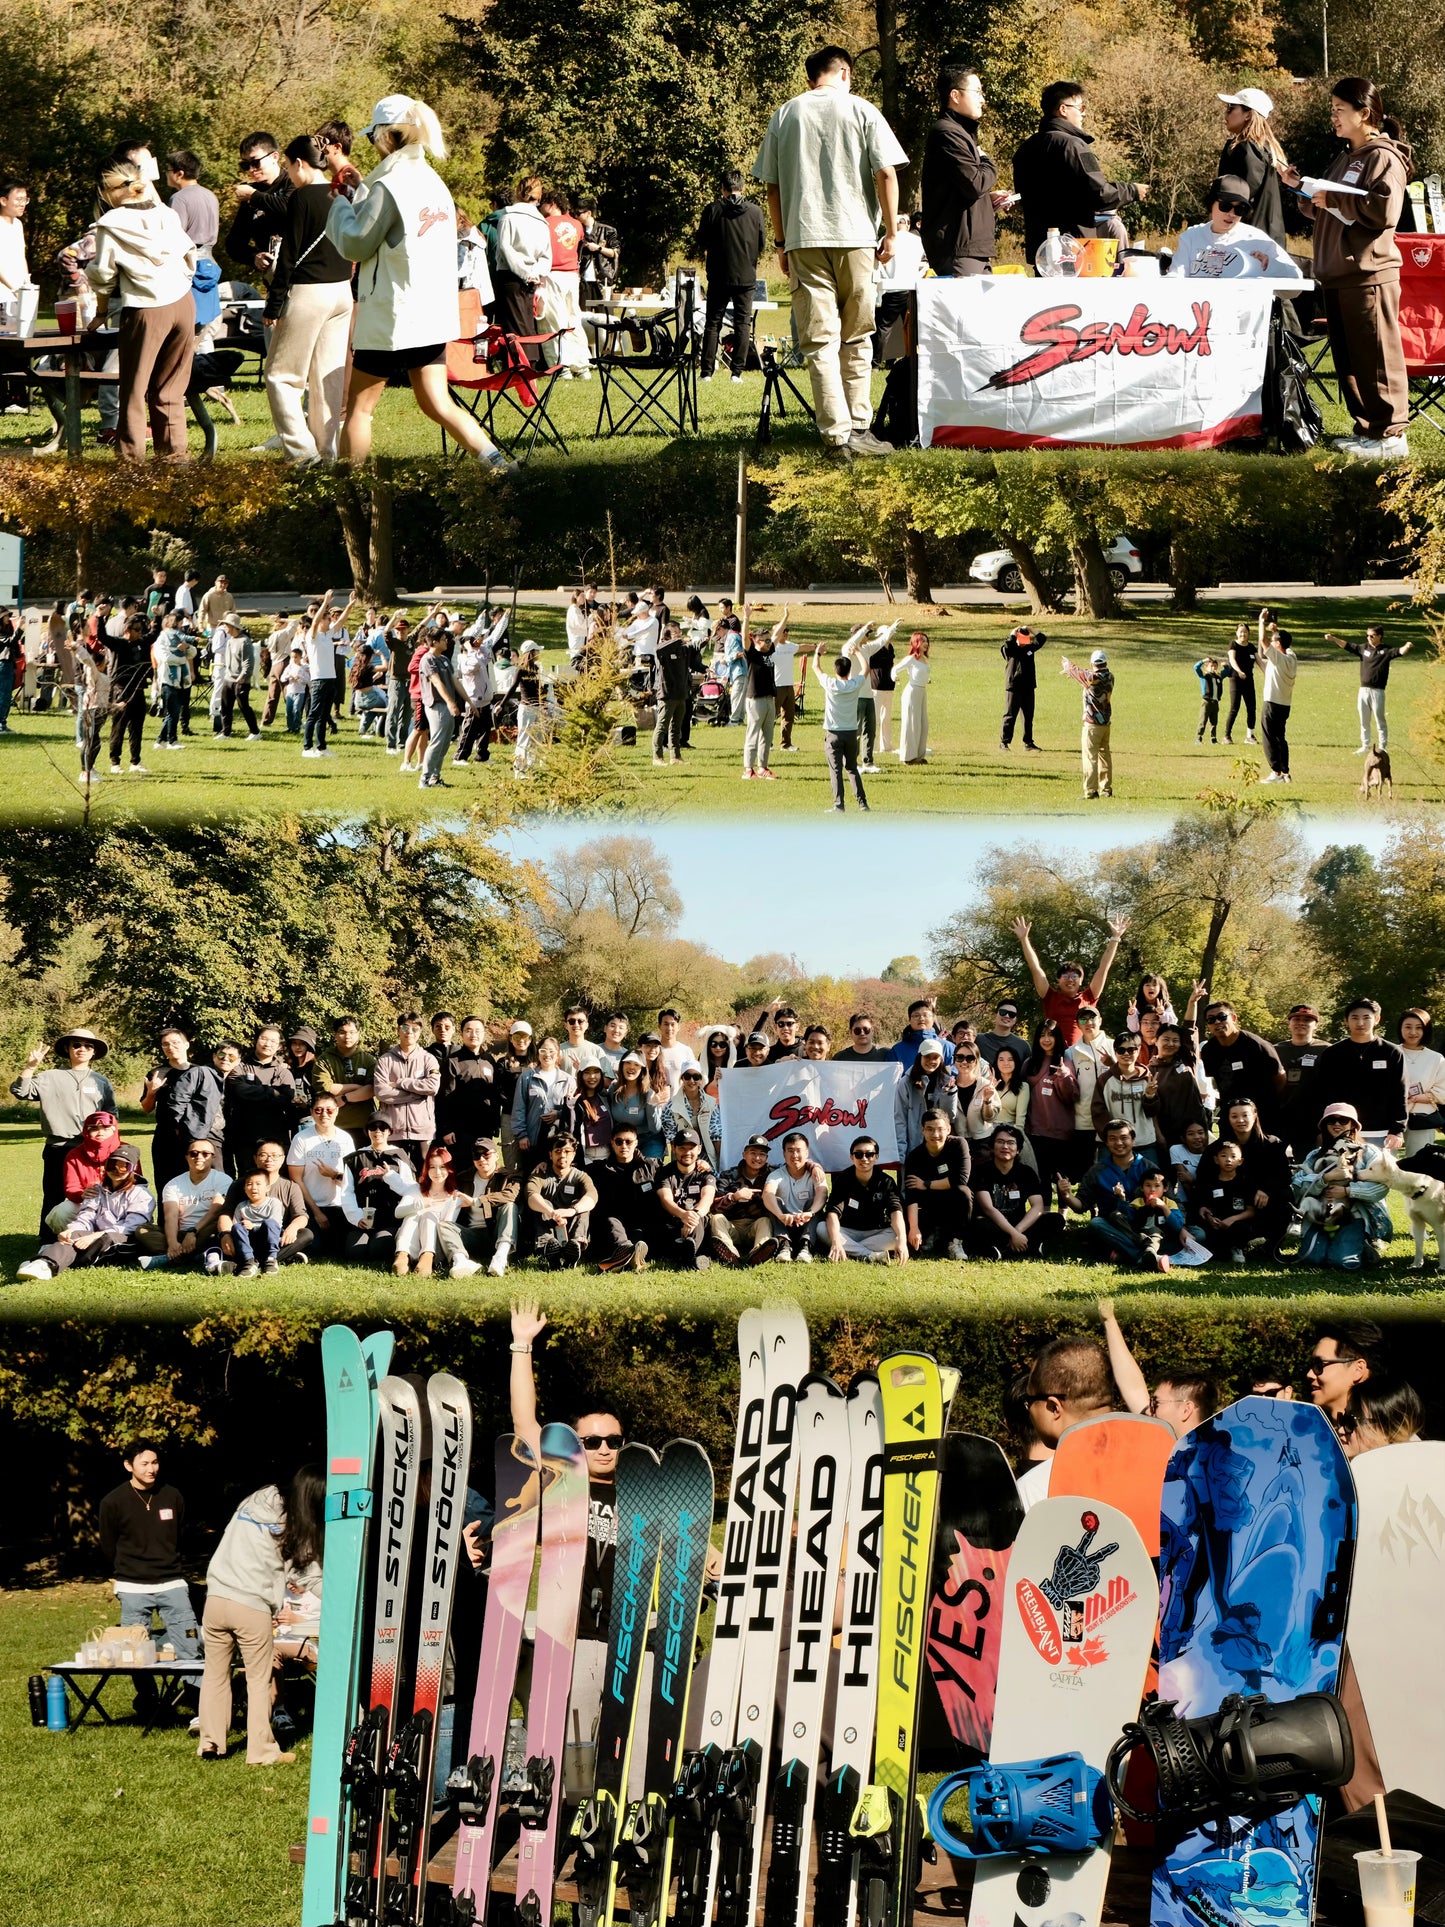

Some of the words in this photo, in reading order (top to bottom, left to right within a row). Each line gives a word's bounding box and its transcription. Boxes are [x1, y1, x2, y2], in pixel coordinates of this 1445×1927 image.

[385, 1403, 409, 1587] STÖCKLI
[432, 1402, 459, 1589] STÖCKLI
[715, 1398, 764, 1638] HEAD
[748, 1384, 797, 1631] HEAD
[890, 1453, 929, 1462] FISCHER
[378, 1628, 398, 1638] WRT
[423, 1630, 443, 1641] WRT
[612, 1513, 647, 1704] FISCHER
[661, 1510, 694, 1705] FISCHER
[793, 1455, 836, 1682] HEAD
[844, 1454, 884, 1686] HEAD
[677, 1786, 684, 1795] 16
[717, 1784, 725, 1793] 16
